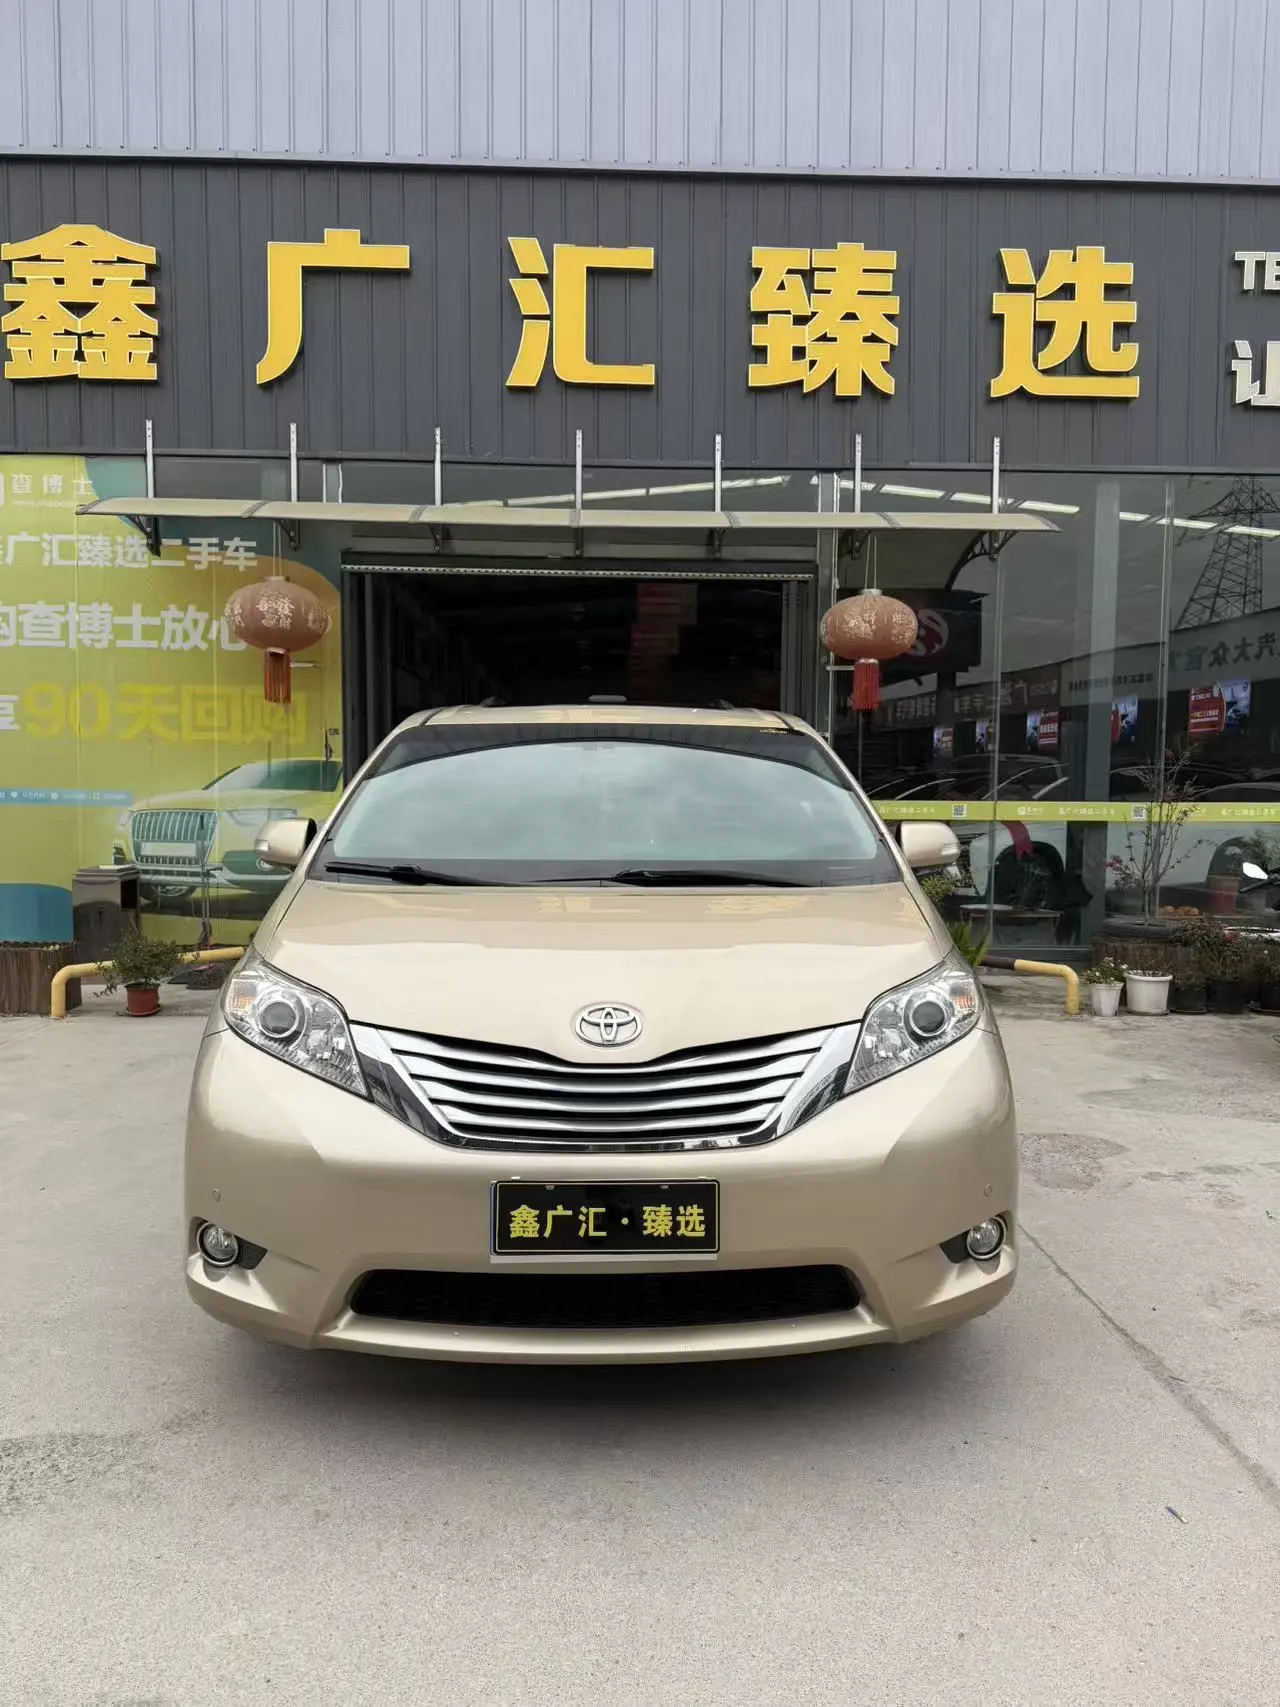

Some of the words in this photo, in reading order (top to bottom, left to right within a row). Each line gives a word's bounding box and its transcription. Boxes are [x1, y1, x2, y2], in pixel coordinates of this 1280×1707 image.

[0, 224, 1140, 398] 鑫广汇臻选
[11, 473, 93, 495] 查博士
[0, 531, 257, 571] 广汇臻选二手车
